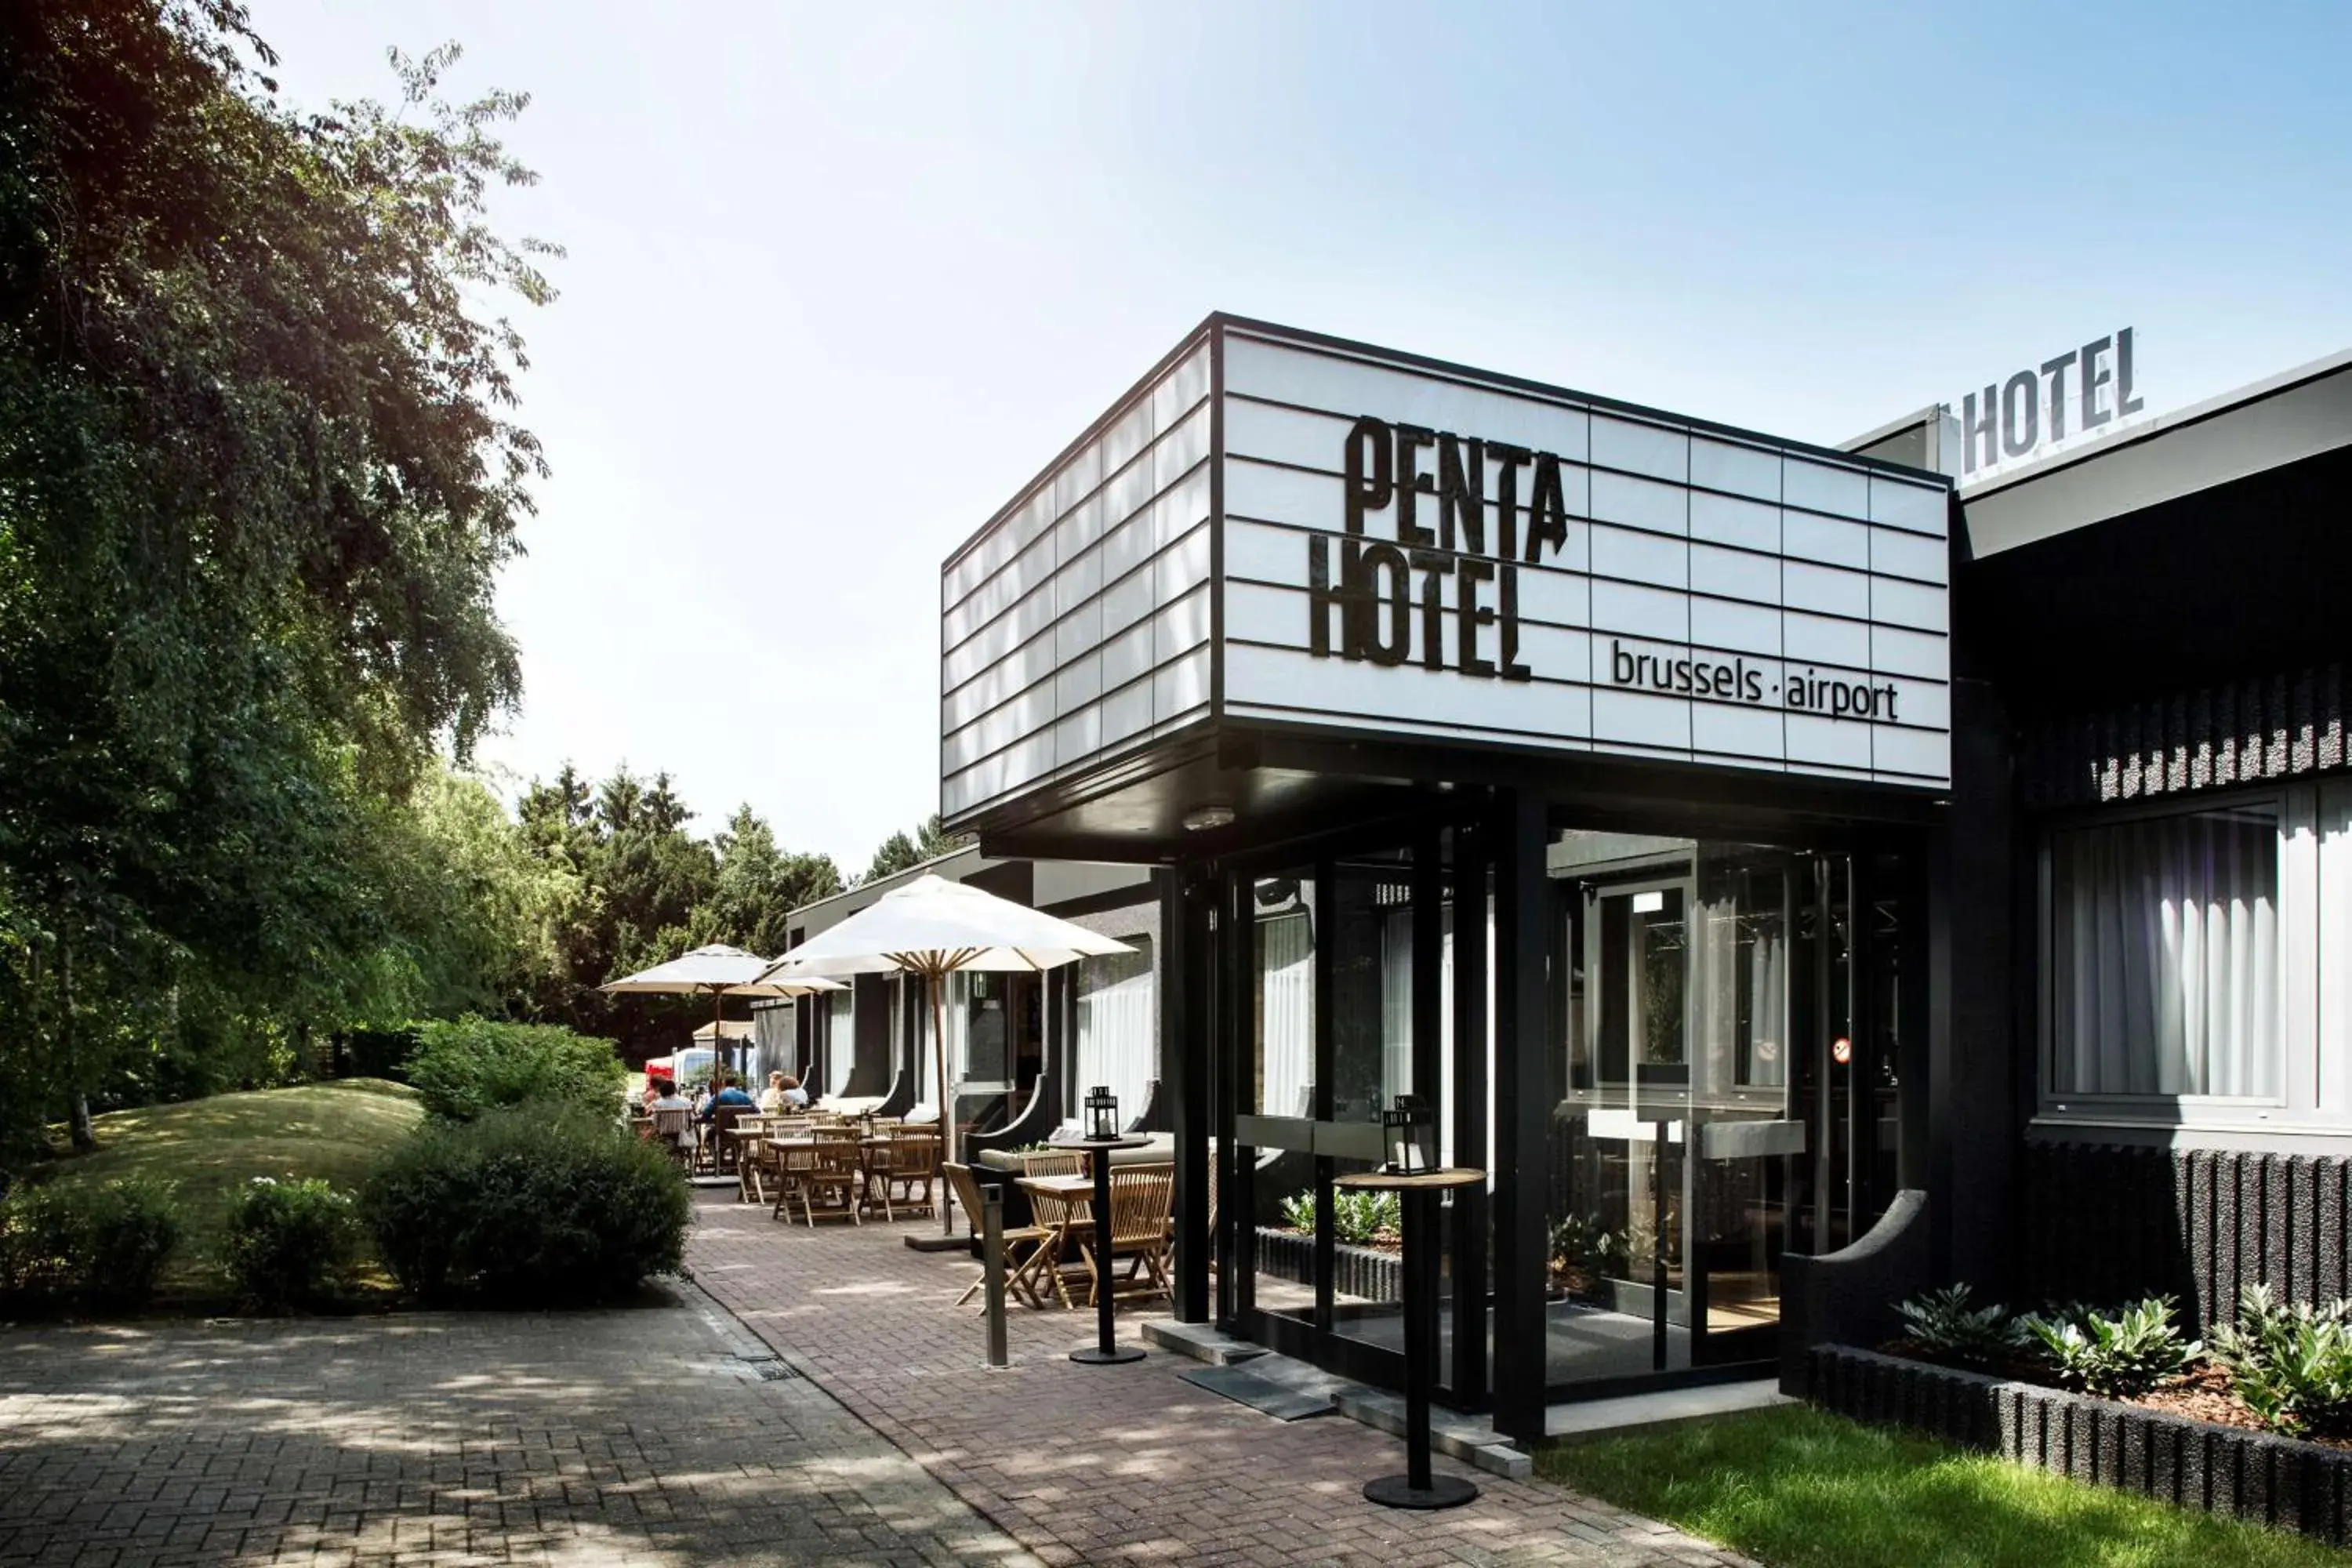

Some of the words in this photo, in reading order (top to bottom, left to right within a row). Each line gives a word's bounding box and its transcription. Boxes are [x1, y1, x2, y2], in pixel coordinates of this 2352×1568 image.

[1962, 326, 2144, 474] HOTEL
[1345, 415, 1568, 565] PENTA
[1308, 533, 1531, 682] HOTEL
[1613, 639, 1762, 702] brussels
[1787, 667, 1900, 721] airport
